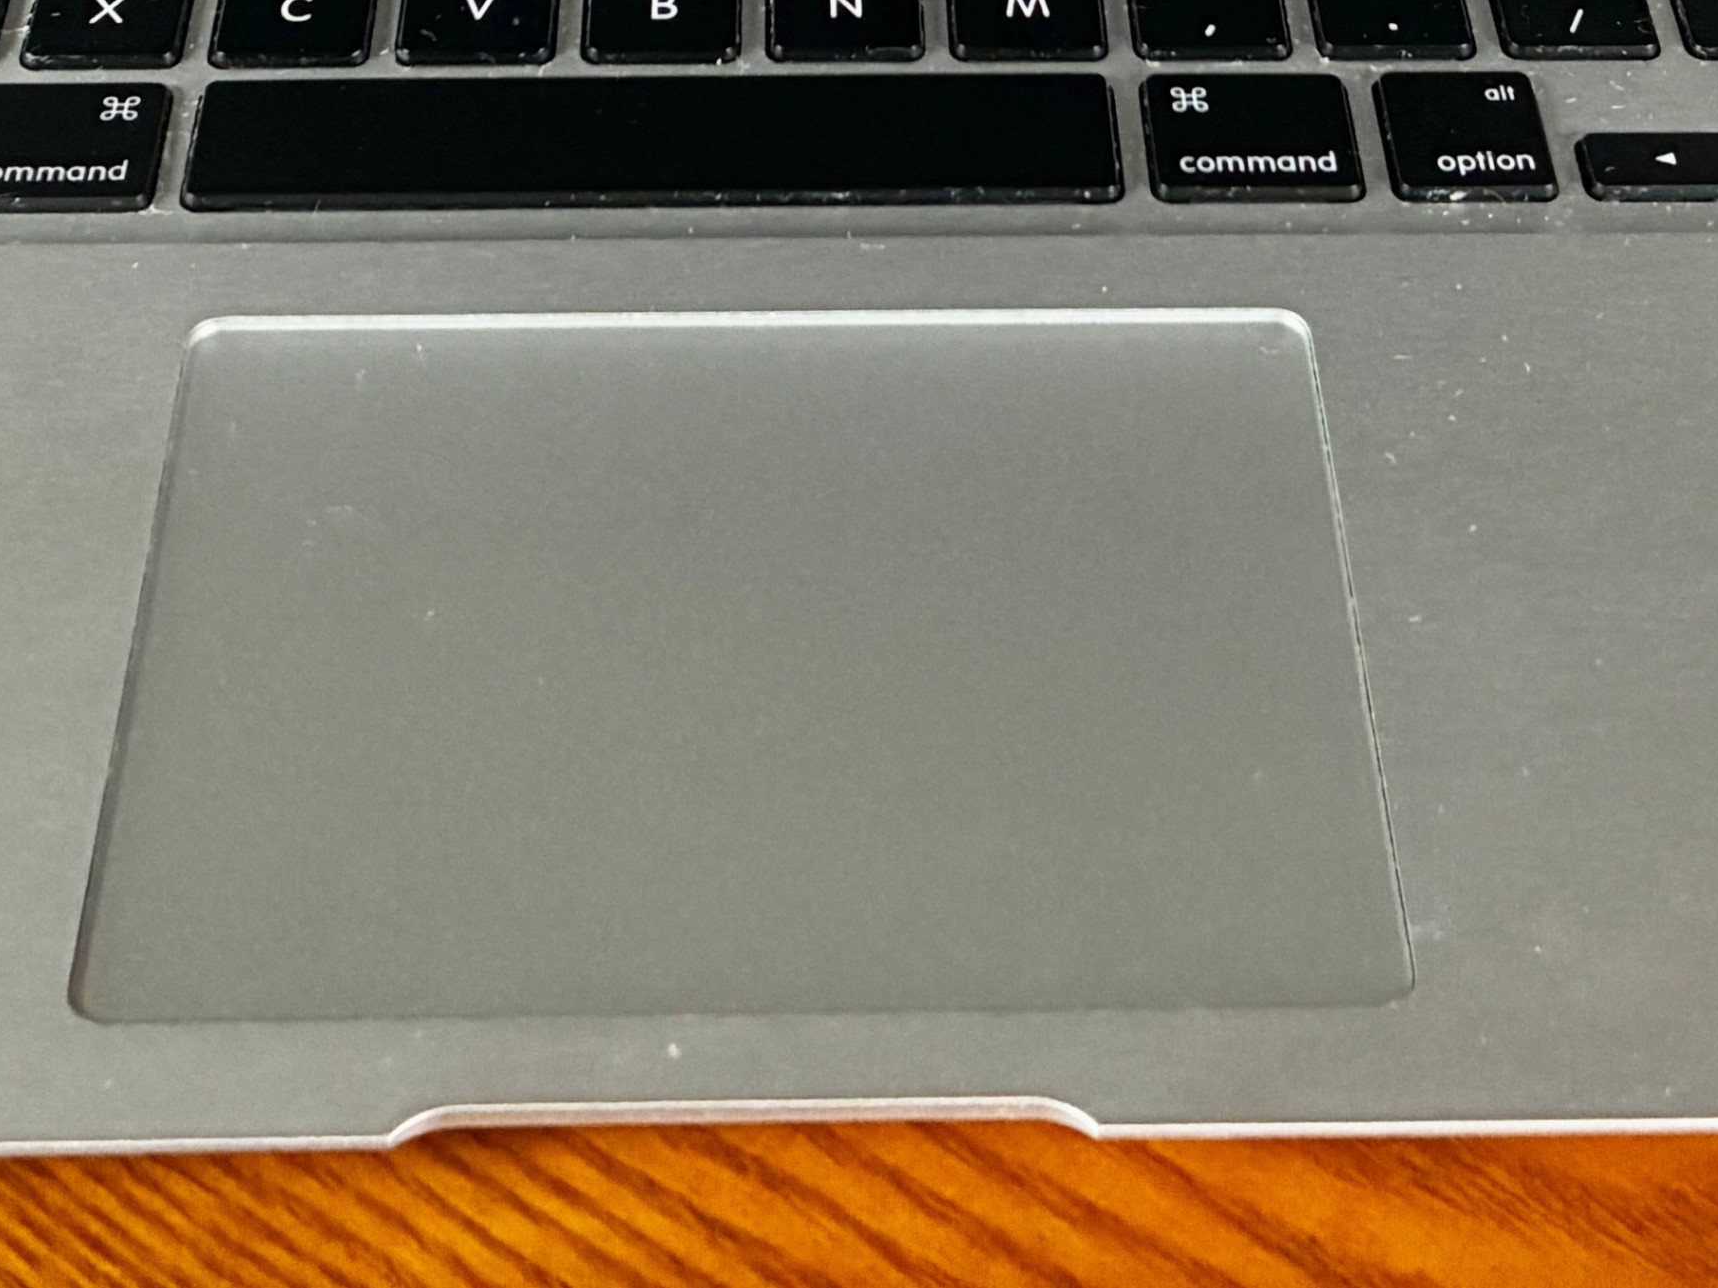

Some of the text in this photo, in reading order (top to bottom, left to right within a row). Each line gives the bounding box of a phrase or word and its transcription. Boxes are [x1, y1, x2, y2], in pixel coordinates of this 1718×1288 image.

[1484, 84, 1515, 101] alt
[1179, 150, 1338, 173] command
[1437, 150, 1536, 176] option
